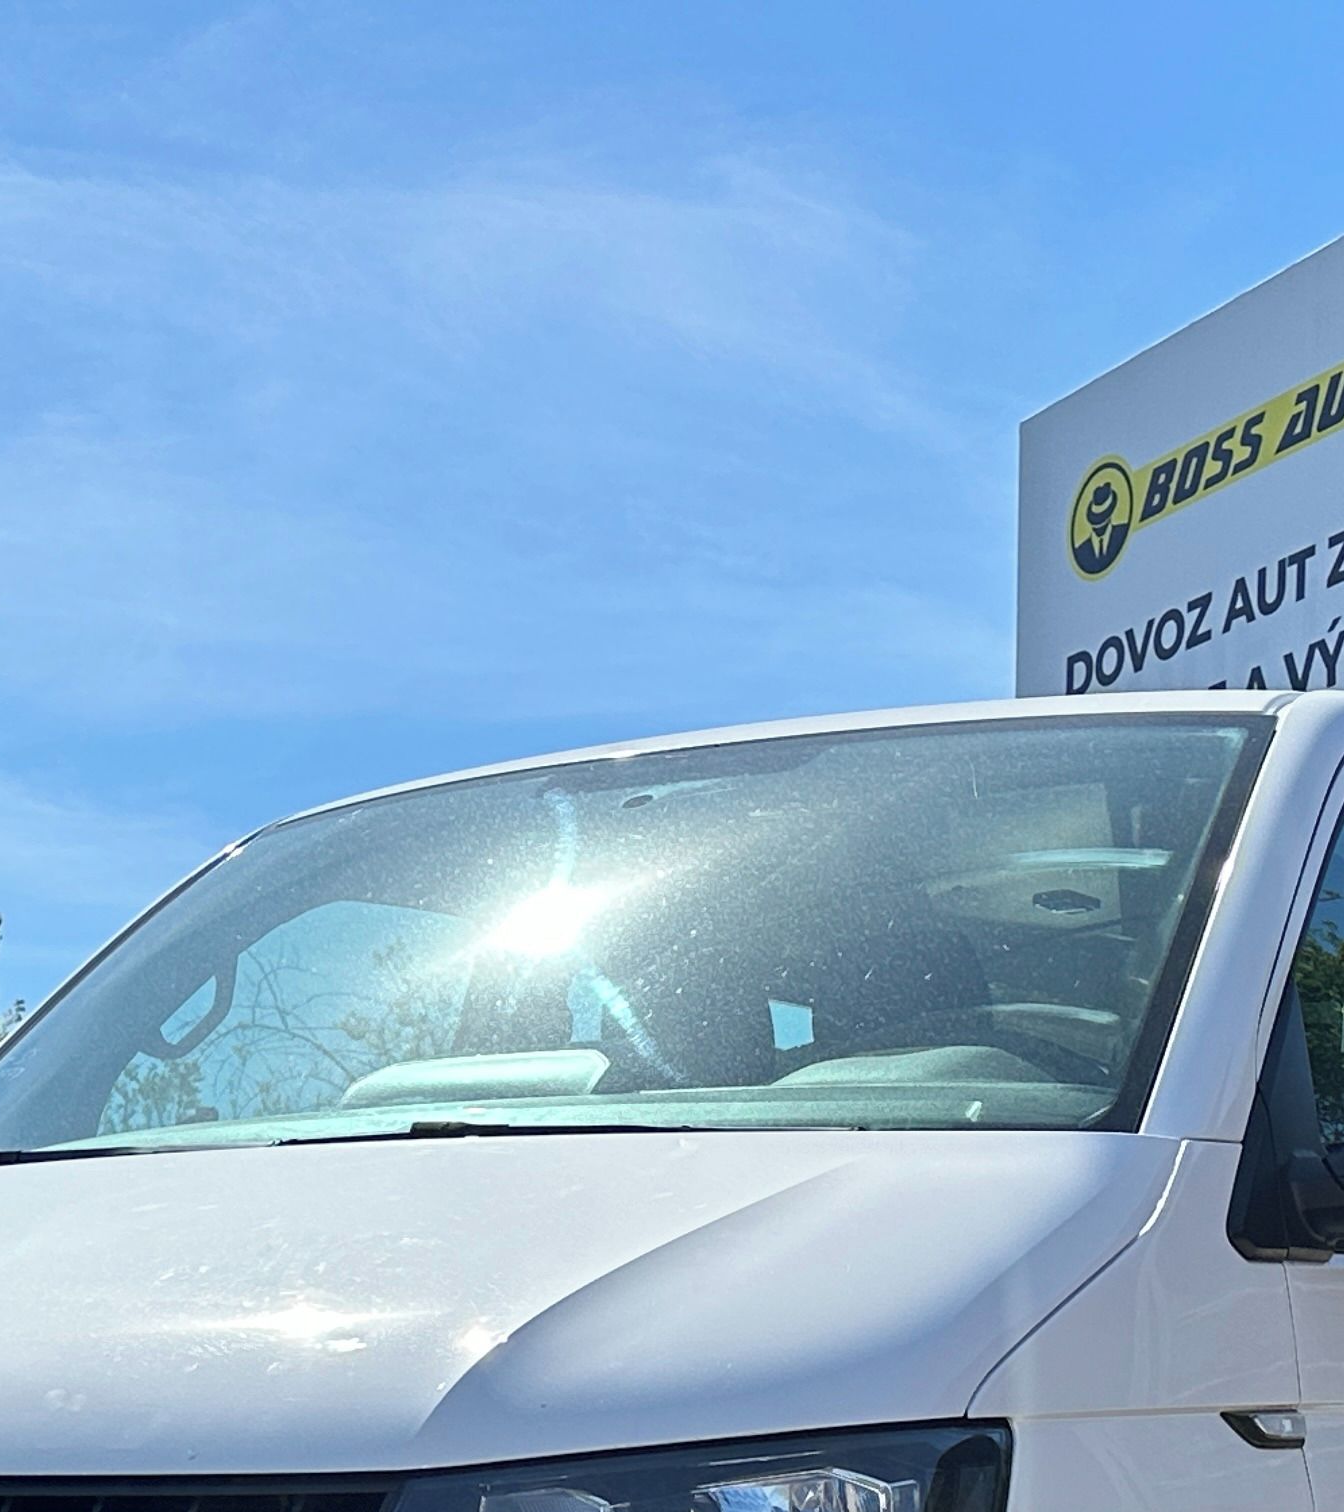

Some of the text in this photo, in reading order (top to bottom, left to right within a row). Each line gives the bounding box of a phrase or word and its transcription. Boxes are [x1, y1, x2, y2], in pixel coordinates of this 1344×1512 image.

[1139, 411, 1264, 522] BOSS
[1065, 592, 1213, 695] DOVOZ
[1221, 544, 1316, 634] AUT
